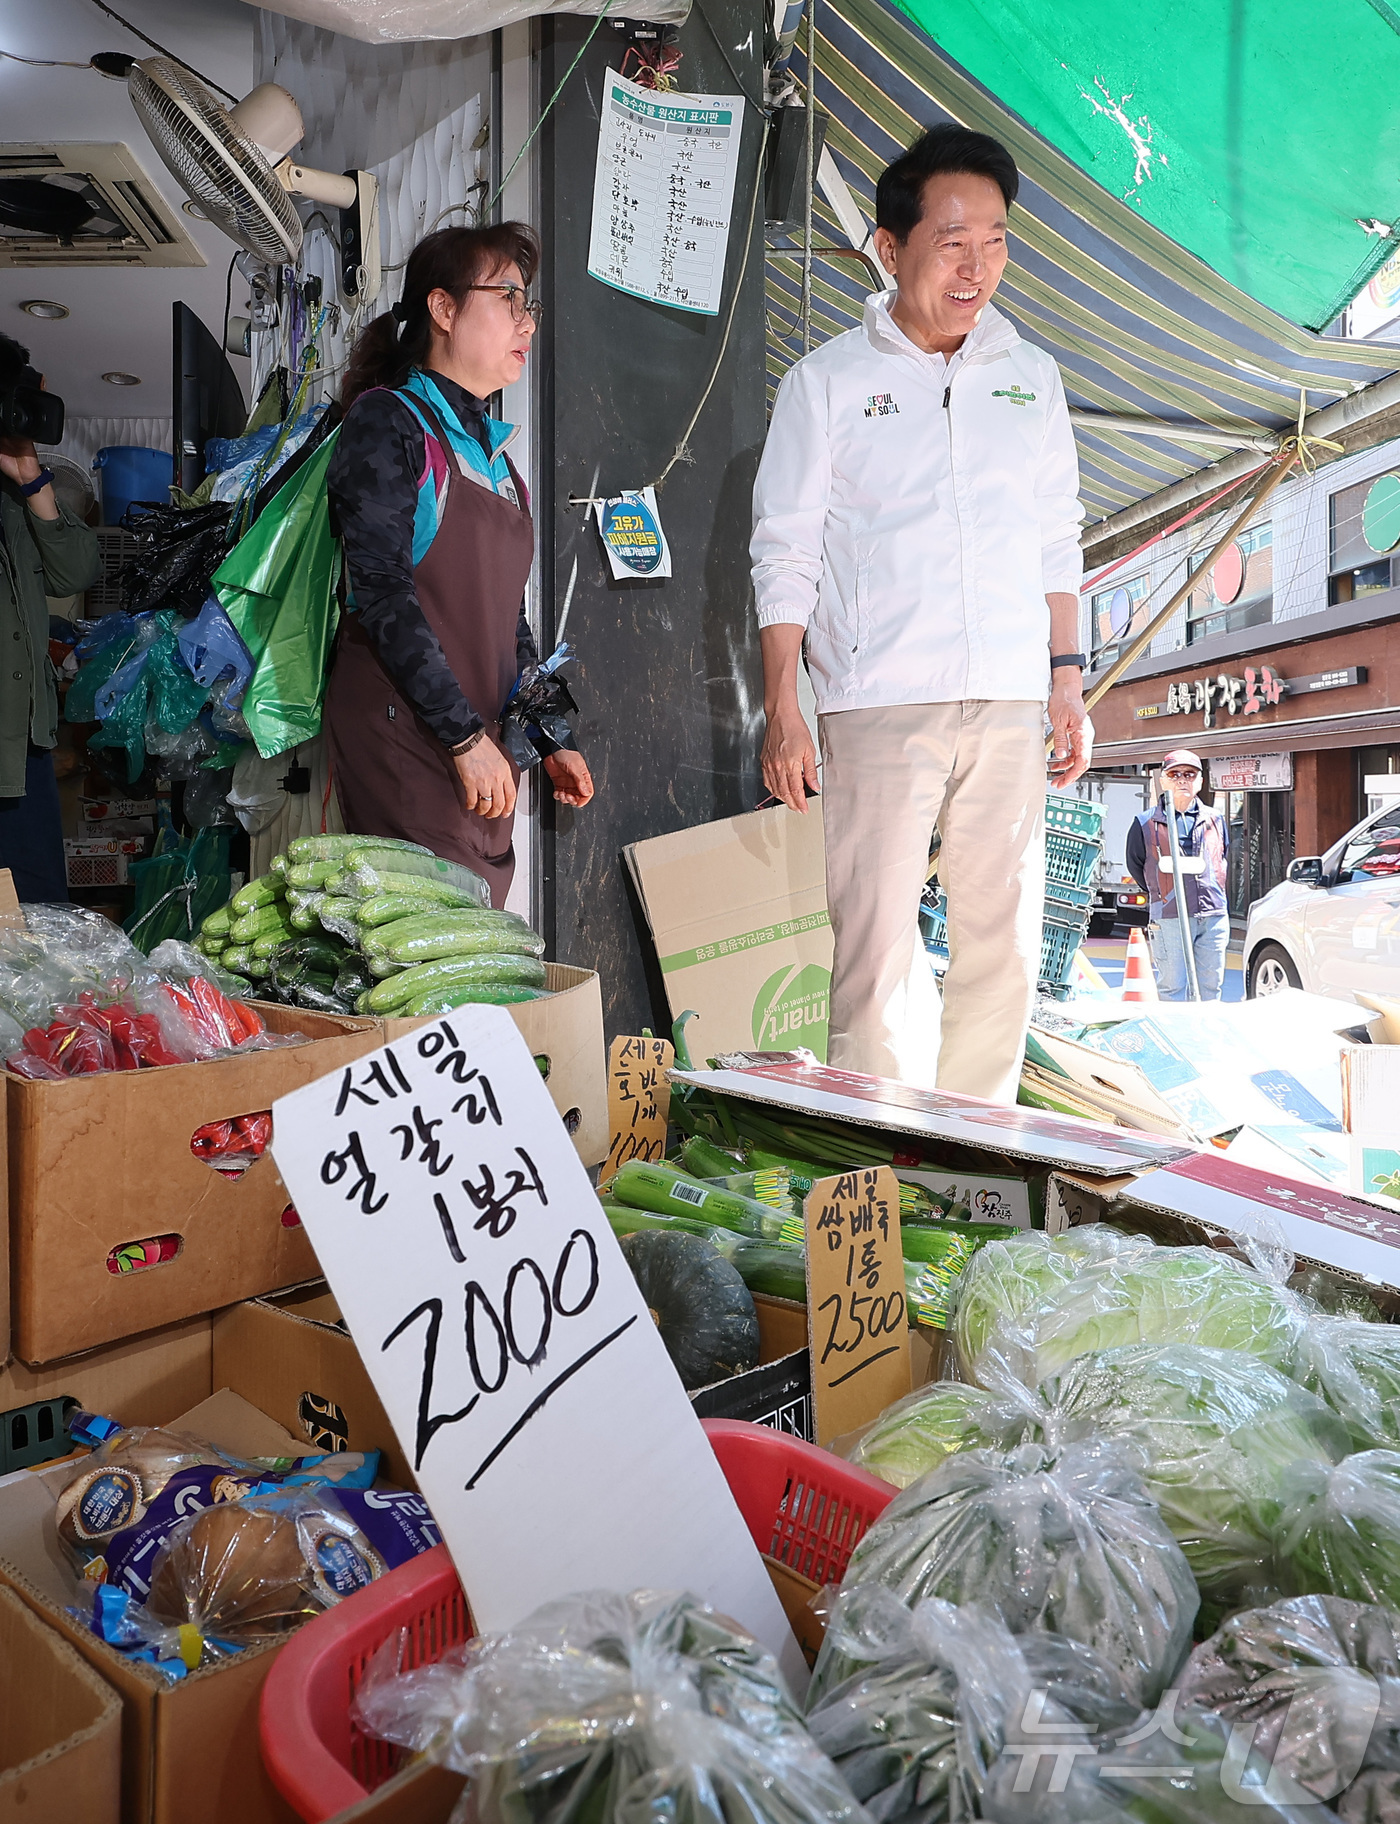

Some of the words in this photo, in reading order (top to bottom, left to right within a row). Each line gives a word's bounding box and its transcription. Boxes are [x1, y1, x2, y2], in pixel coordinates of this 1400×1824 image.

[621, 94, 655, 117] 농수산물
[658, 107, 687, 121] 원산지
[689, 111, 719, 123] 표시판
[668, 186, 687, 198] 국산
[668, 199, 687, 211] 국산
[611, 515, 645, 531] 고유가
[606, 531, 658, 546] 피해지원금
[695, 945, 716, 961] 운영
[719, 928, 775, 955] 온라인쇼핑몰
[619, 1038, 665, 1066] 세일
[335, 1021, 480, 1116] 세일
[614, 1061, 658, 1101] 호박
[631, 1100, 658, 1127] 1개
[610, 1132, 663, 1168] 1000
[831, 1170, 878, 1202] 세일
[818, 1291, 905, 1364] 2500
[381, 1228, 599, 1472] 2000
[83, 1485, 107, 1514] 대한민국
[89, 1501, 105, 1525] 소비자
[95, 1507, 114, 1530] 브랜드
[108, 1490, 124, 1507] 대상
